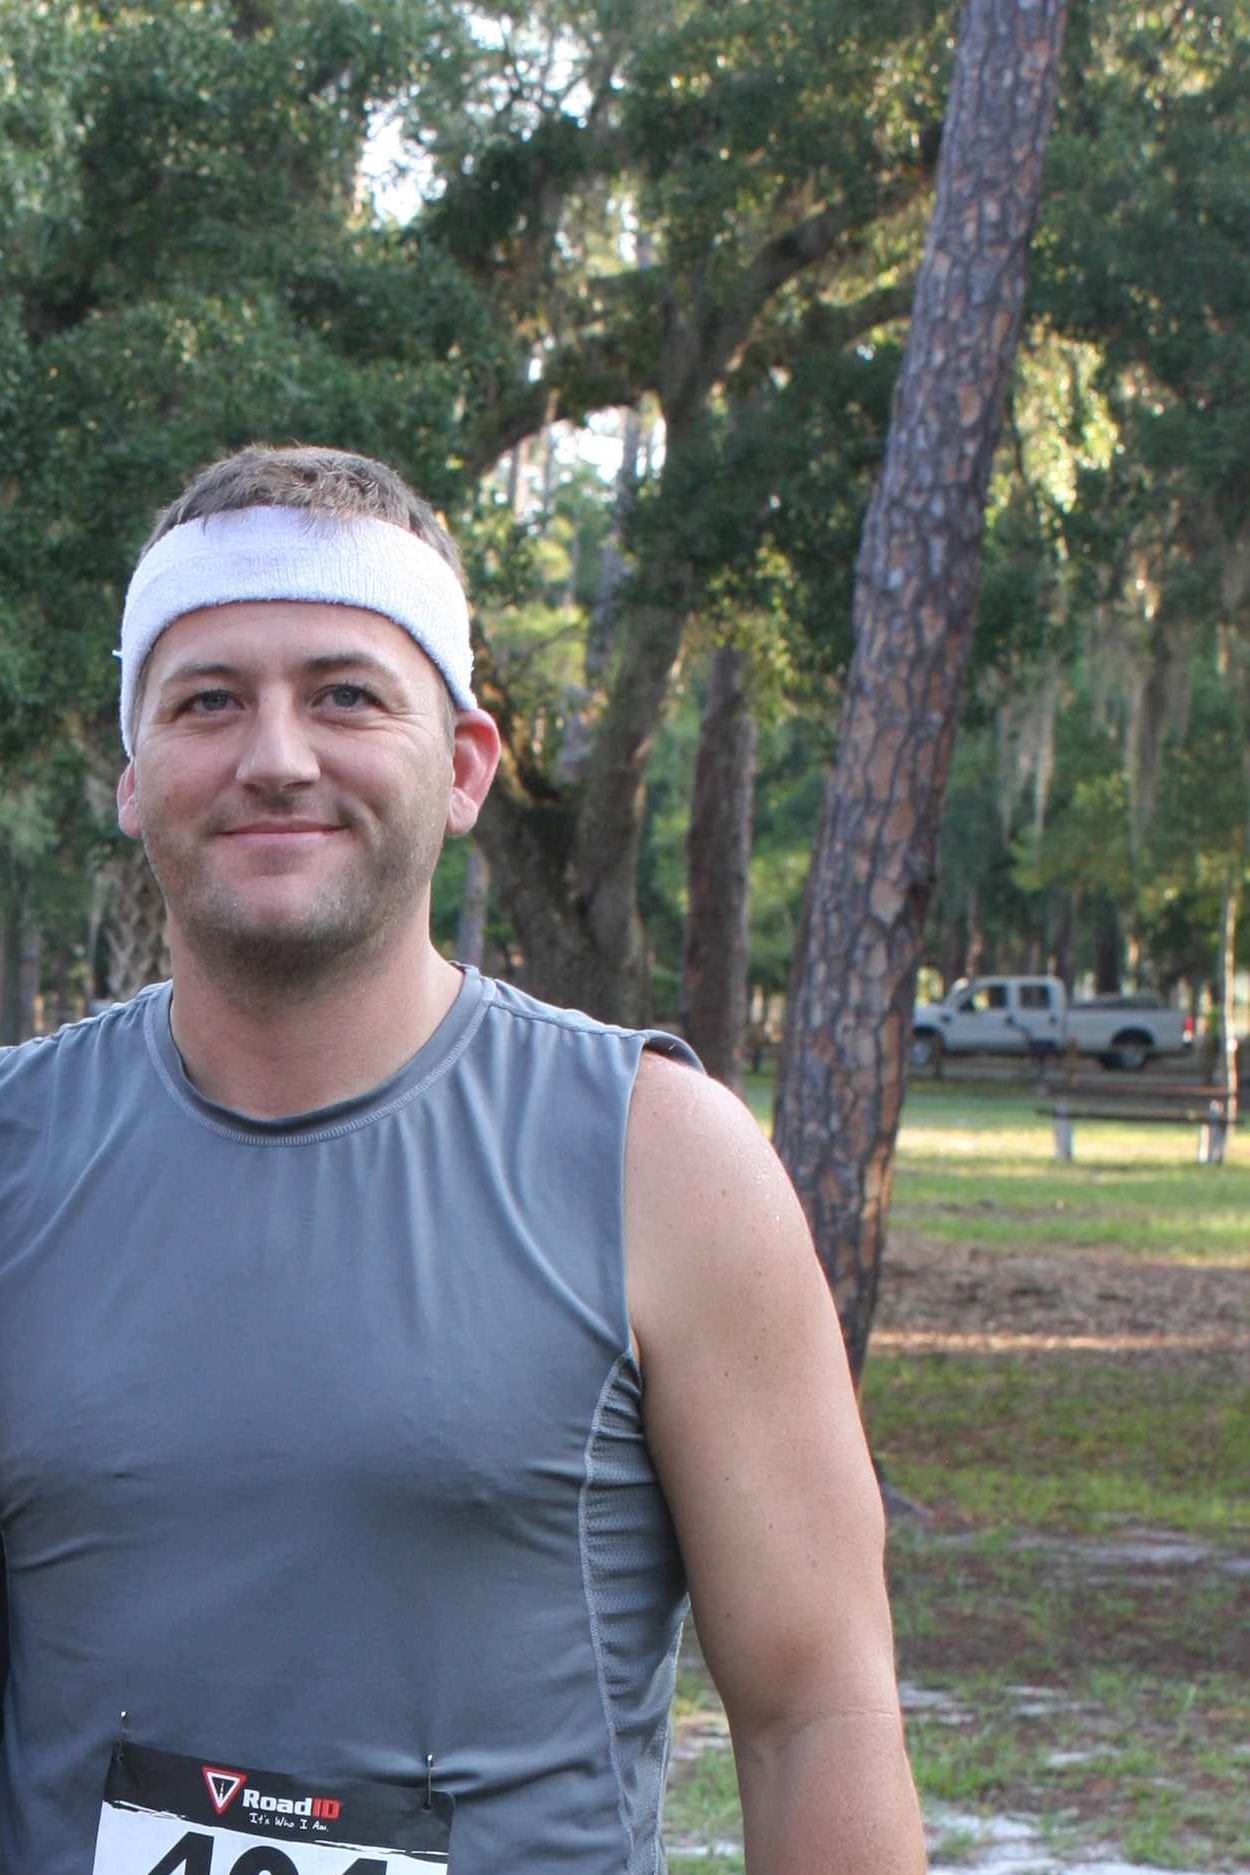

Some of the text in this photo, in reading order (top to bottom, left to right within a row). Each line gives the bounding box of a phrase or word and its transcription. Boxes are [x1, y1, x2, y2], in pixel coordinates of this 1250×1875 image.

[249, 1812, 270, 1825] It's
[275, 1817, 295, 1828] Who
[300, 1819, 308, 1830] I
